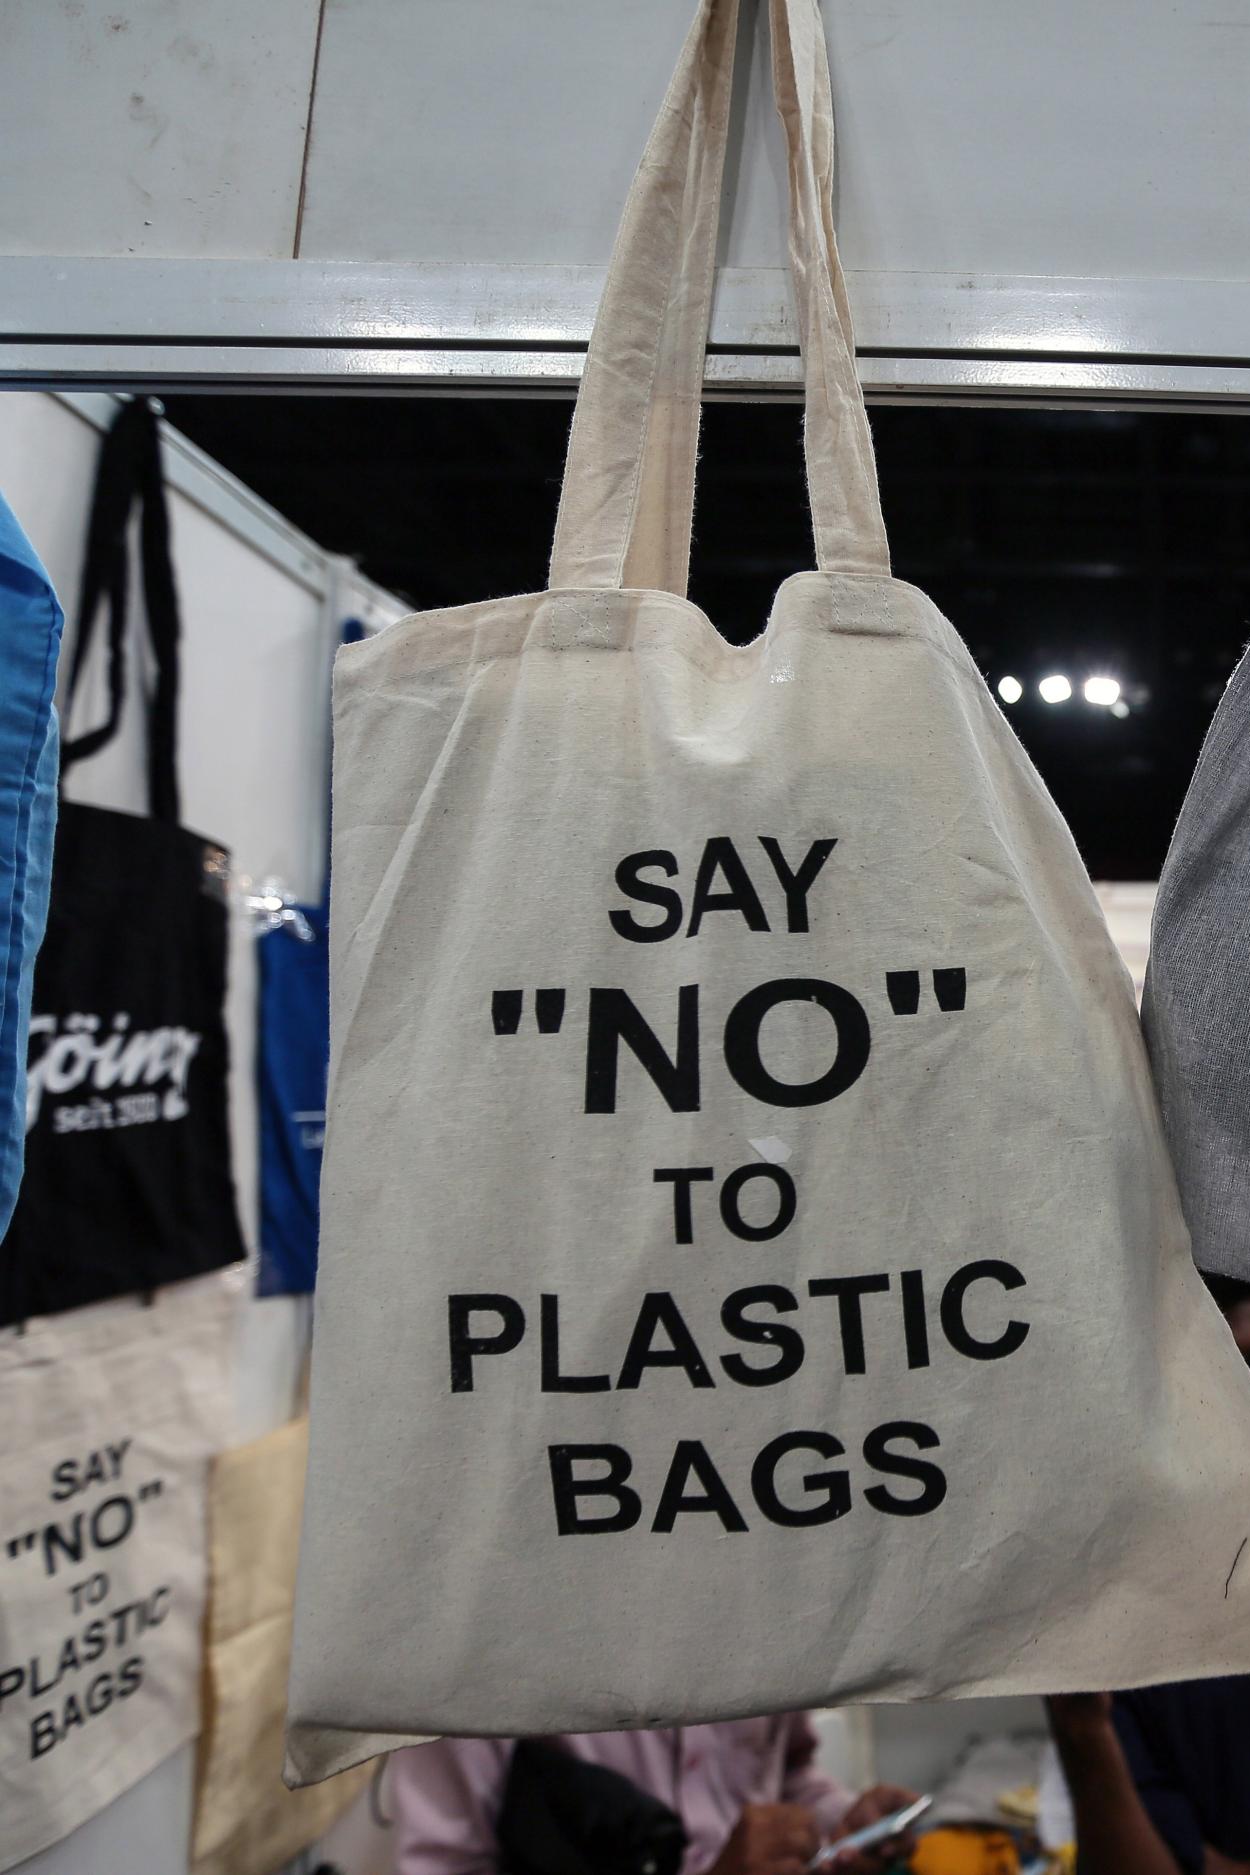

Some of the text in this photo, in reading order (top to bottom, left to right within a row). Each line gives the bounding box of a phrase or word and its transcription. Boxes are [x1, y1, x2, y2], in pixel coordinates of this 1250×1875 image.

[608, 836, 838, 943] SAY
[492, 967, 967, 1114] "NO"
[654, 1163, 797, 1245] TO
[448, 1259, 1030, 1393] PLASTIC
[50, 1437, 133, 1501] SAY
[548, 1421, 947, 1536] BAGS
[6, 1479, 164, 1577] "NO"
[67, 1571, 112, 1616] TO
[0, 1585, 172, 1710] PLASTIC
[29, 1654, 146, 1761] BAGS
